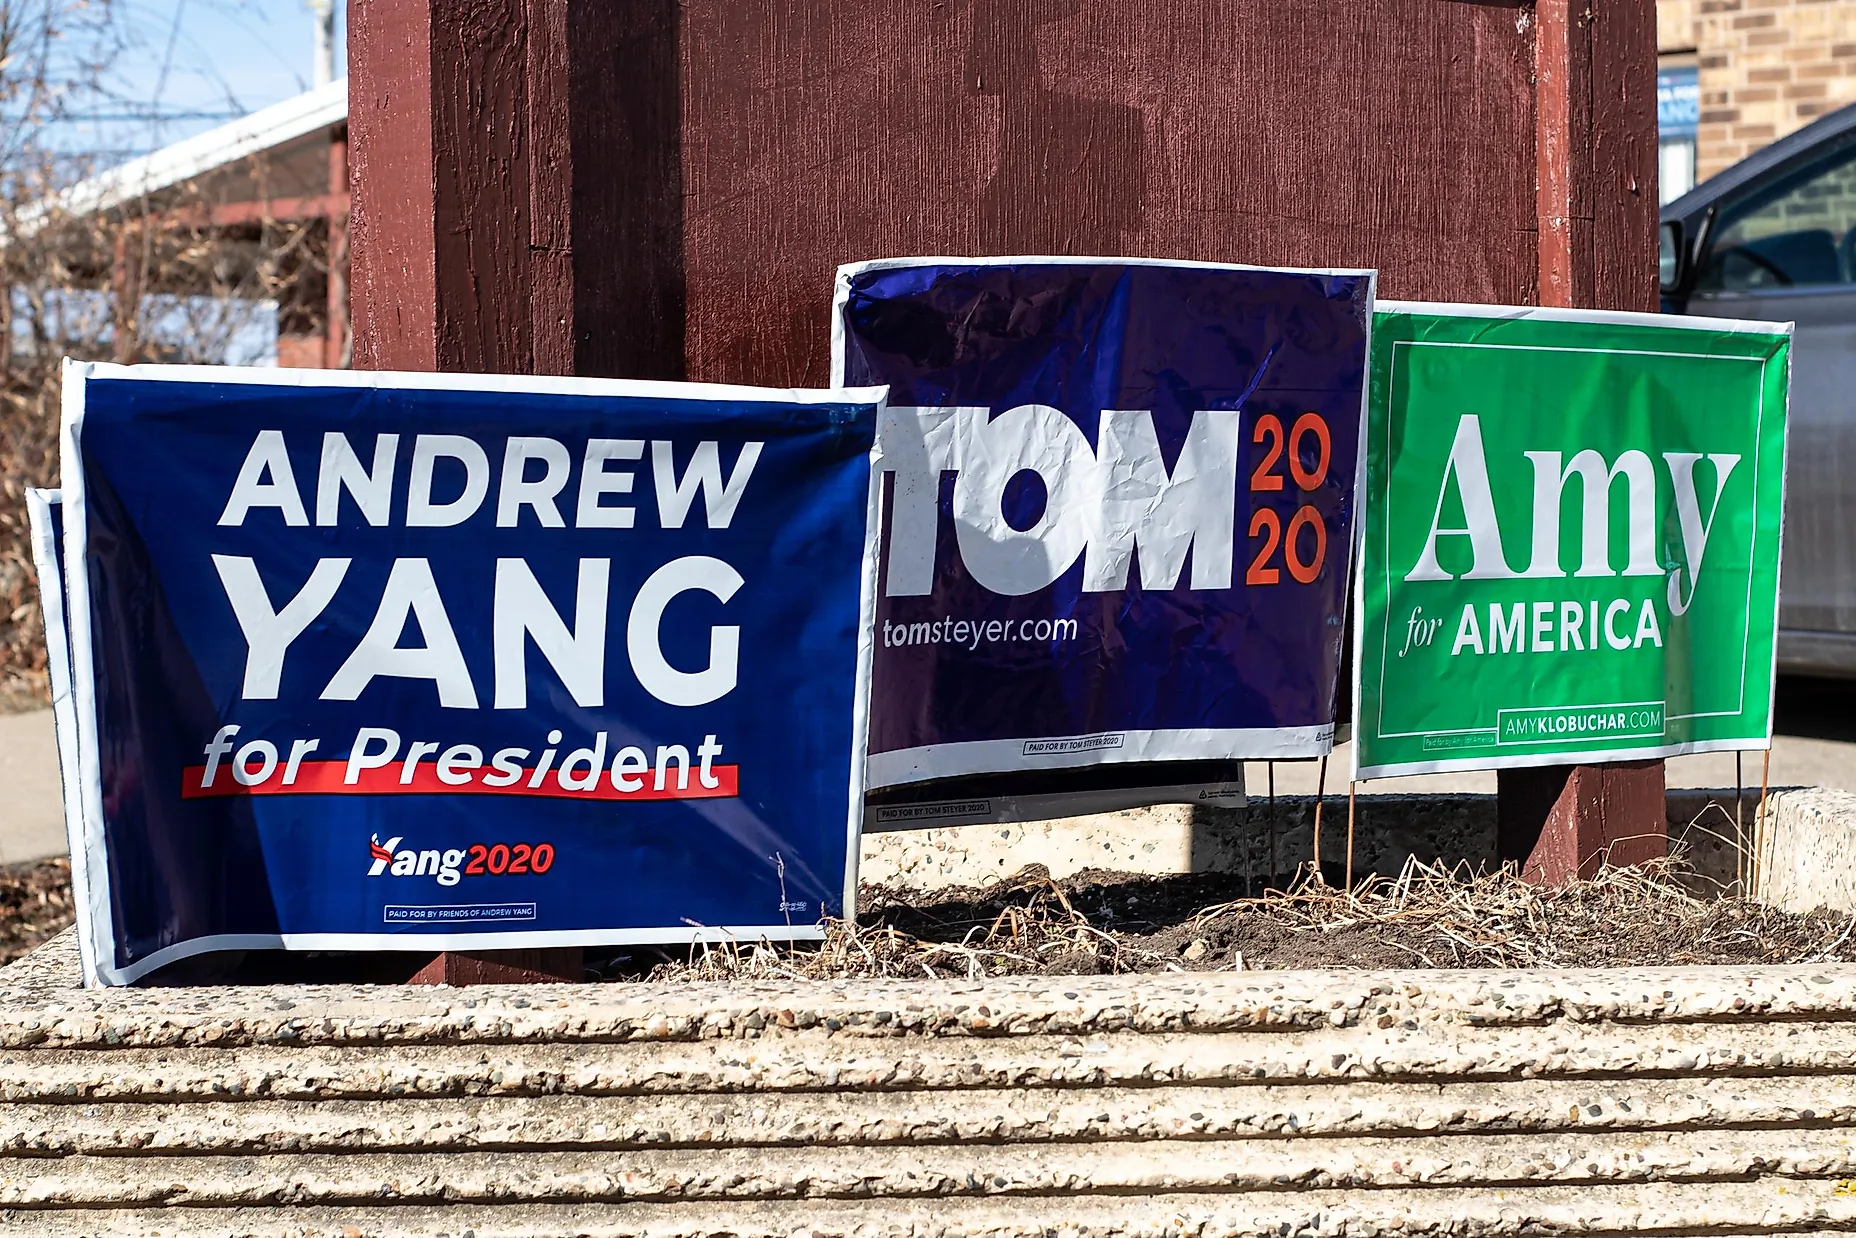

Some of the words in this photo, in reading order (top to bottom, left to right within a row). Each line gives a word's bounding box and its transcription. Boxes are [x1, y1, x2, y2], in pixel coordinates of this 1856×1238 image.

[216, 429, 766, 529] ANDREW
[1250, 412, 1331, 491] 20
[883, 404, 1240, 597] TOM
[1404, 413, 1742, 617] Amy
[1246, 505, 1327, 585] 20
[210, 553, 745, 710] YANG
[883, 615, 1078, 651] tomsteyer.com
[1399, 606, 1442, 657] for
[1451, 598, 1664, 656] AMERICA
[1029, 743, 1044, 751] PAID
[1045, 742, 1058, 750] FOR
[1060, 742, 1069, 750] BY
[1069, 741, 1082, 749] TOM
[1083, 739, 1102, 748] STEYER
[1103, 736, 1119, 745] 2020
[1505, 710, 1661, 736] AMYKLOBUCHAR.COM
[201, 724, 320, 789] for
[344, 726, 723, 793] President
[882, 810, 898, 818] PAID
[899, 809, 913, 817] FOR
[914, 808, 924, 816] BY
[925, 807, 941, 815] TOM
[942, 805, 966, 814] STEYER
[967, 803, 985, 812] 2020
[388, 910, 408, 918] PAID
[409, 910, 425, 918] FOR
[427, 910, 437, 918] BY
[438, 909, 469, 918] FRIENDS
[470, 909, 480, 917] OF
[481, 908, 511, 916] ANDREW
[512, 907, 533, 915] YANG
